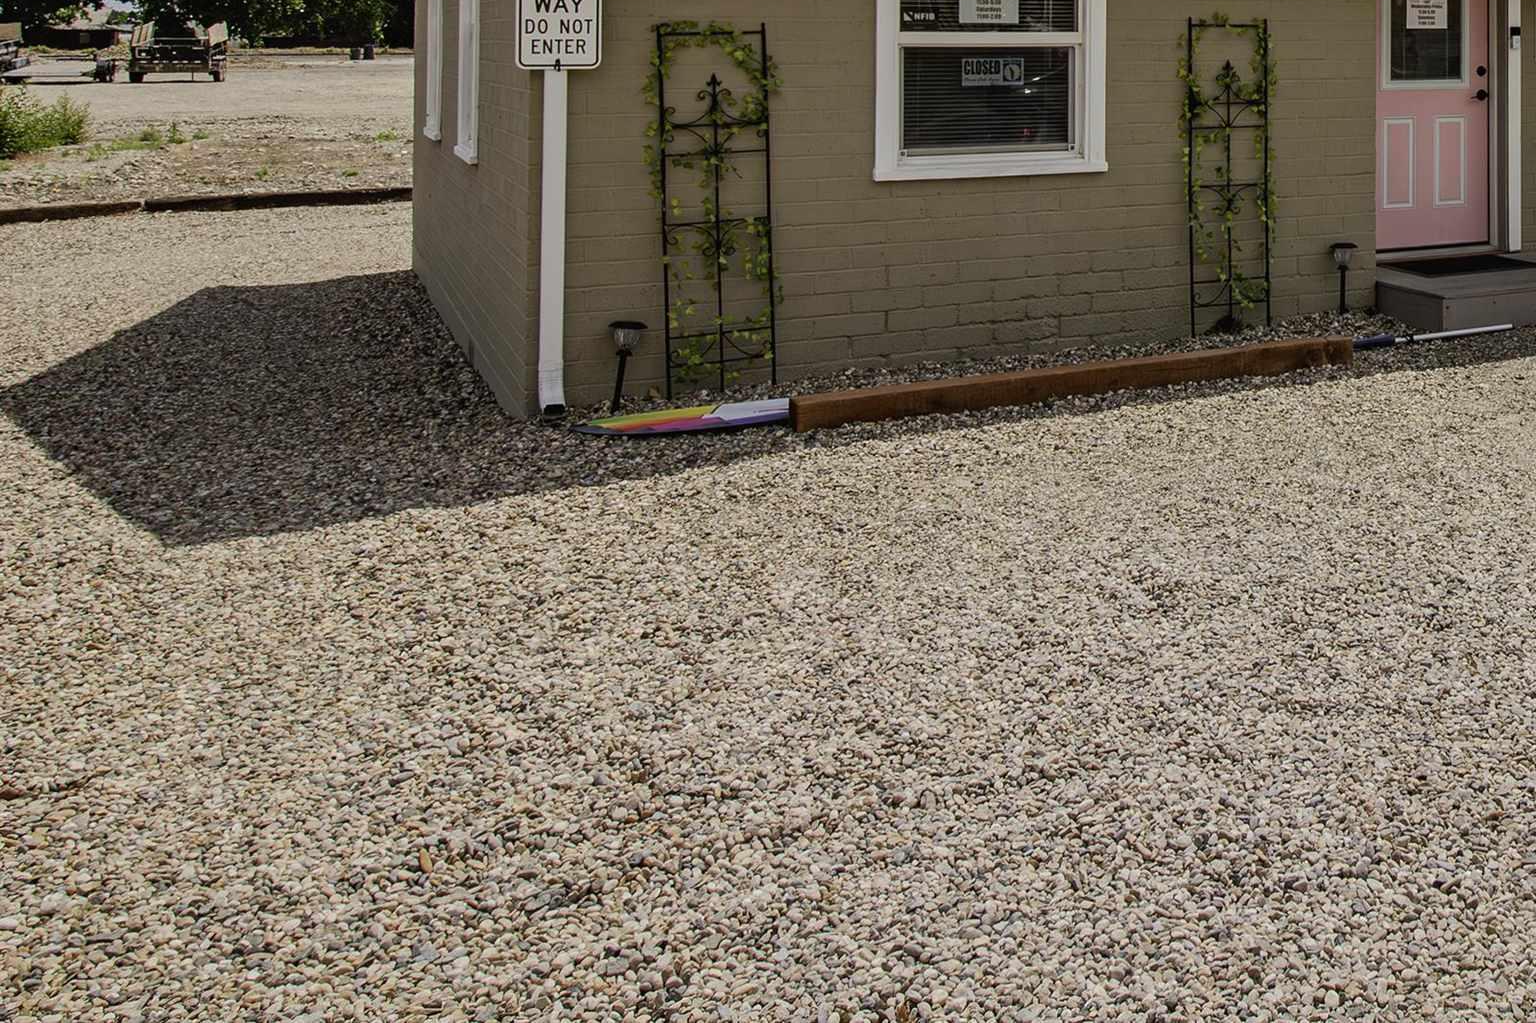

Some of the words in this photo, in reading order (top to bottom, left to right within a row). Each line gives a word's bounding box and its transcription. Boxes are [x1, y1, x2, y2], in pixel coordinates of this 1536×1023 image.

[525, 19, 548, 34] DO
[560, 19, 593, 34] NOT
[531, 39, 586, 54] ENTER
[964, 60, 1000, 75] CLOSED
